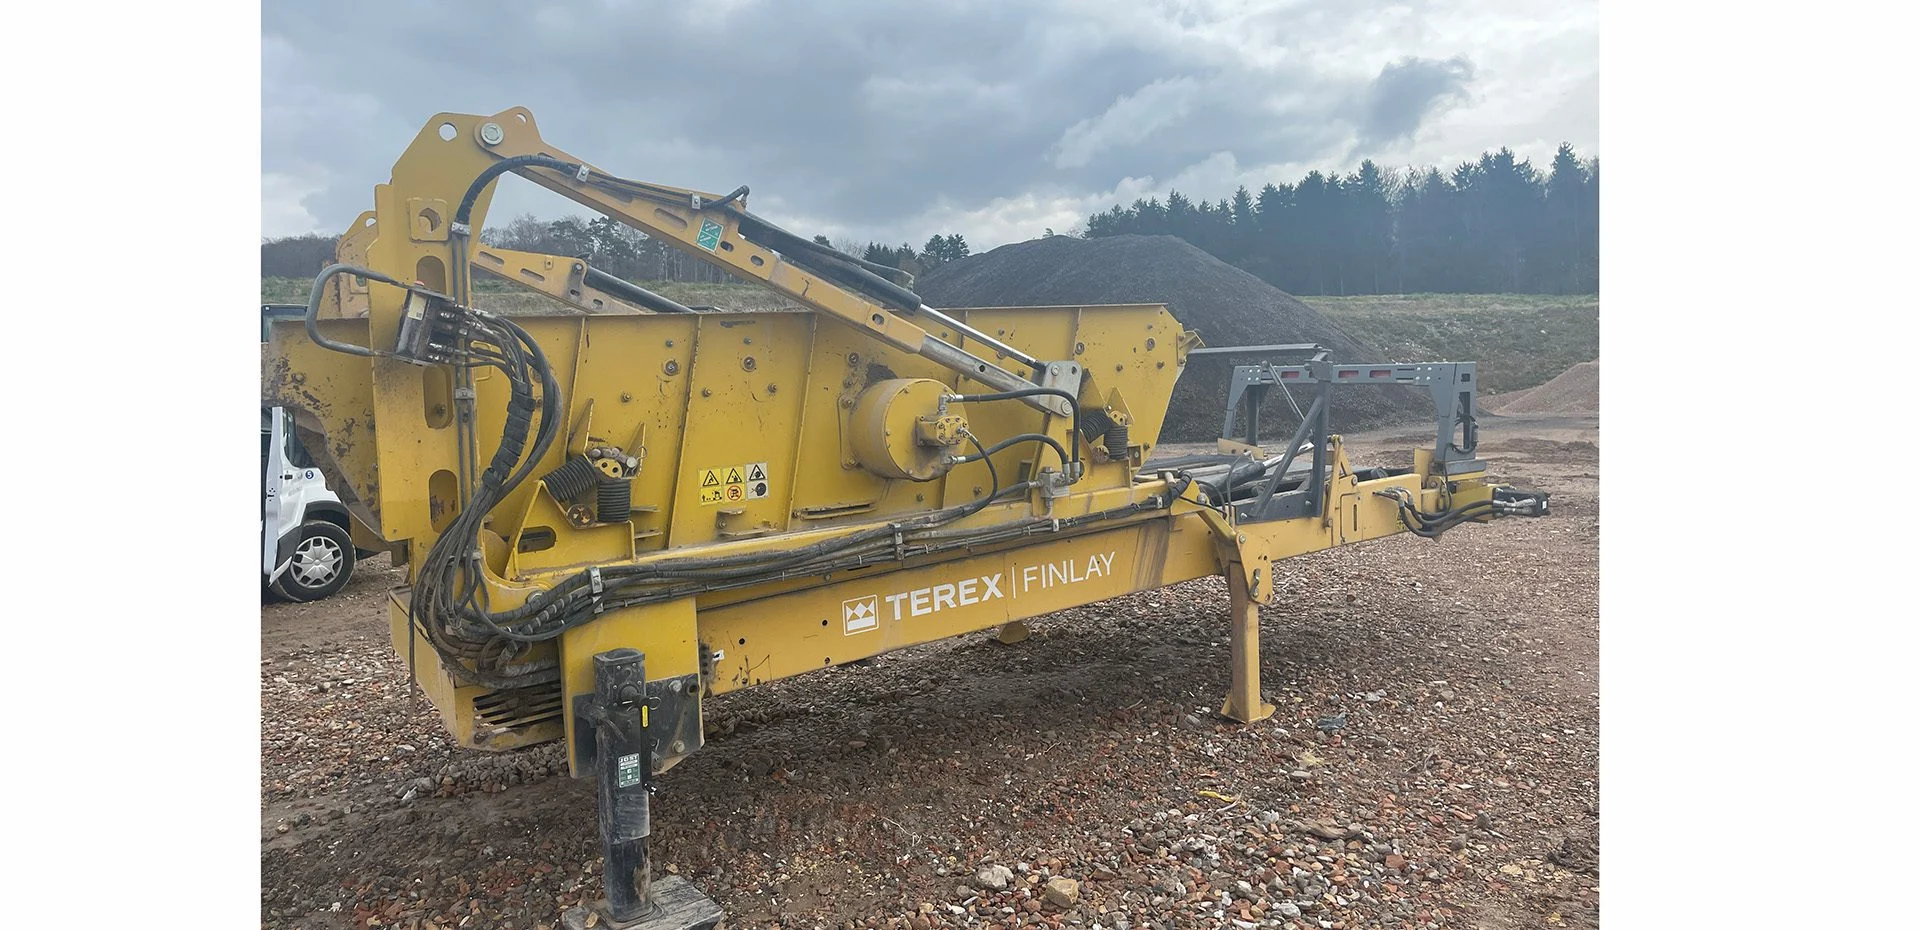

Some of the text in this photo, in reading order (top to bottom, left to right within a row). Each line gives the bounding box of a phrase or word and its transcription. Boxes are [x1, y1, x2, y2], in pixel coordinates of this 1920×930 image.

[307, 471, 313, 479] 5
[885, 551, 1115, 620] TEREX FINLAY
